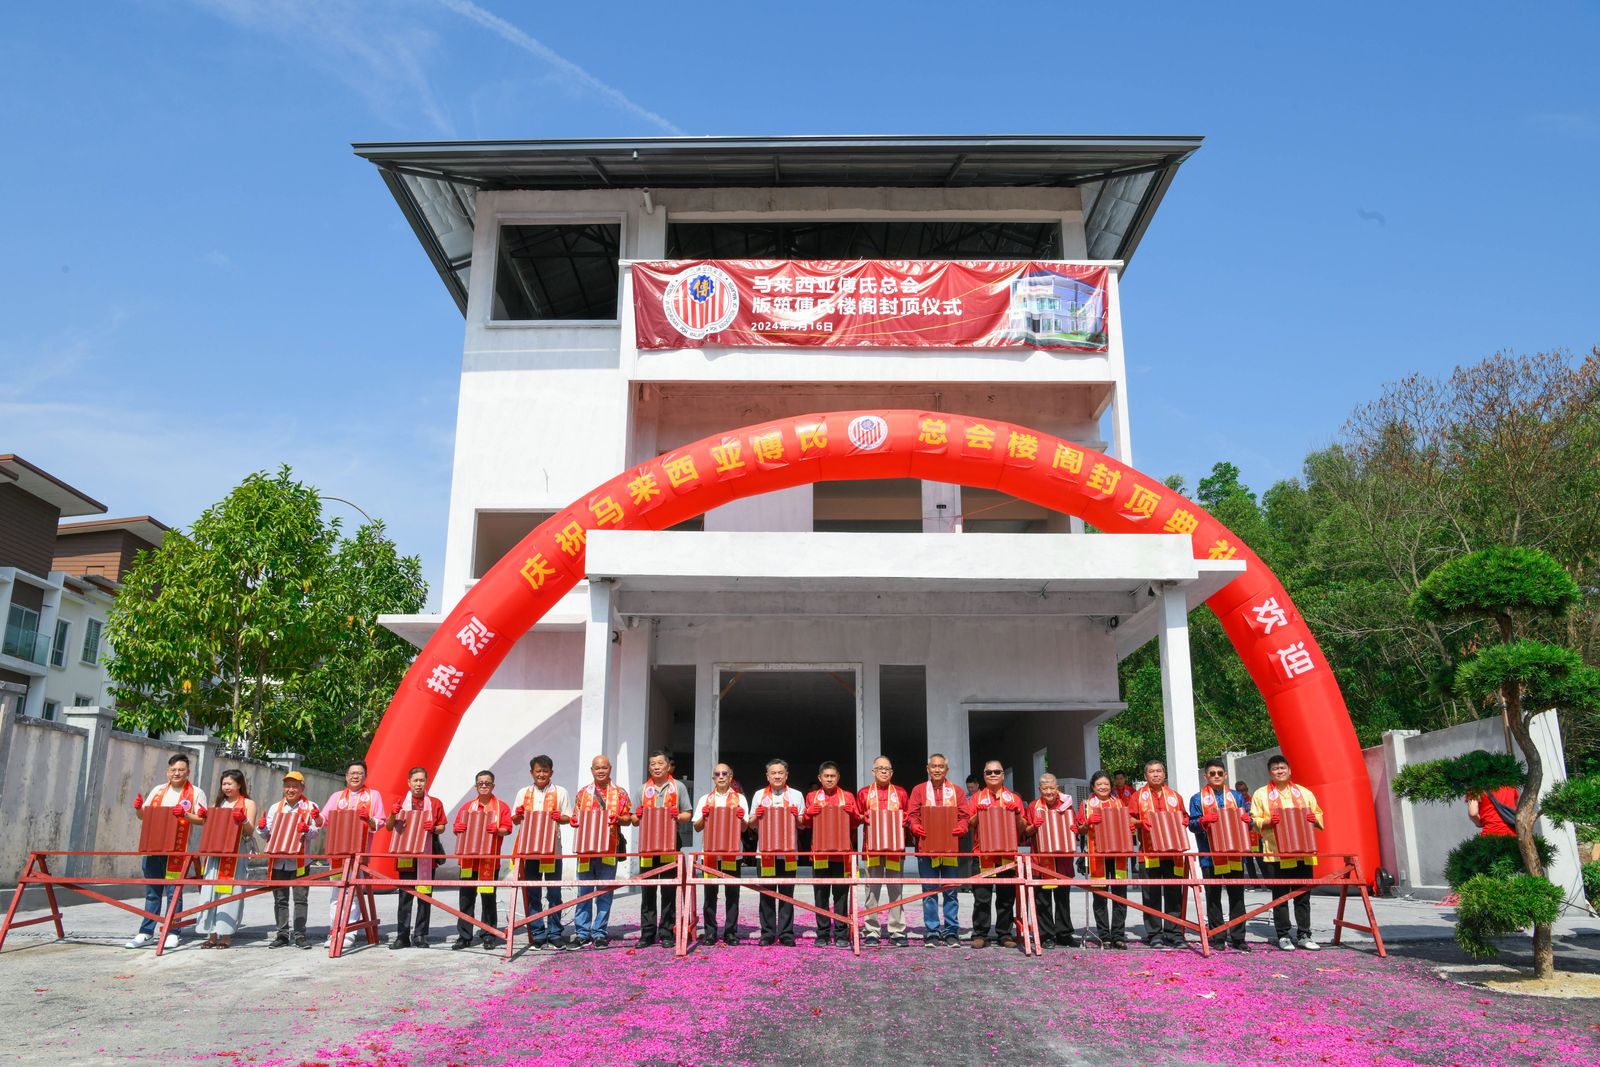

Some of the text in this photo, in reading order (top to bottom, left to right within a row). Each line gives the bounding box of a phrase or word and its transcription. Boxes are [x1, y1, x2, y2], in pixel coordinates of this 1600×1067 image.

[752, 275, 921, 295] 马来西亚傅氏总会
